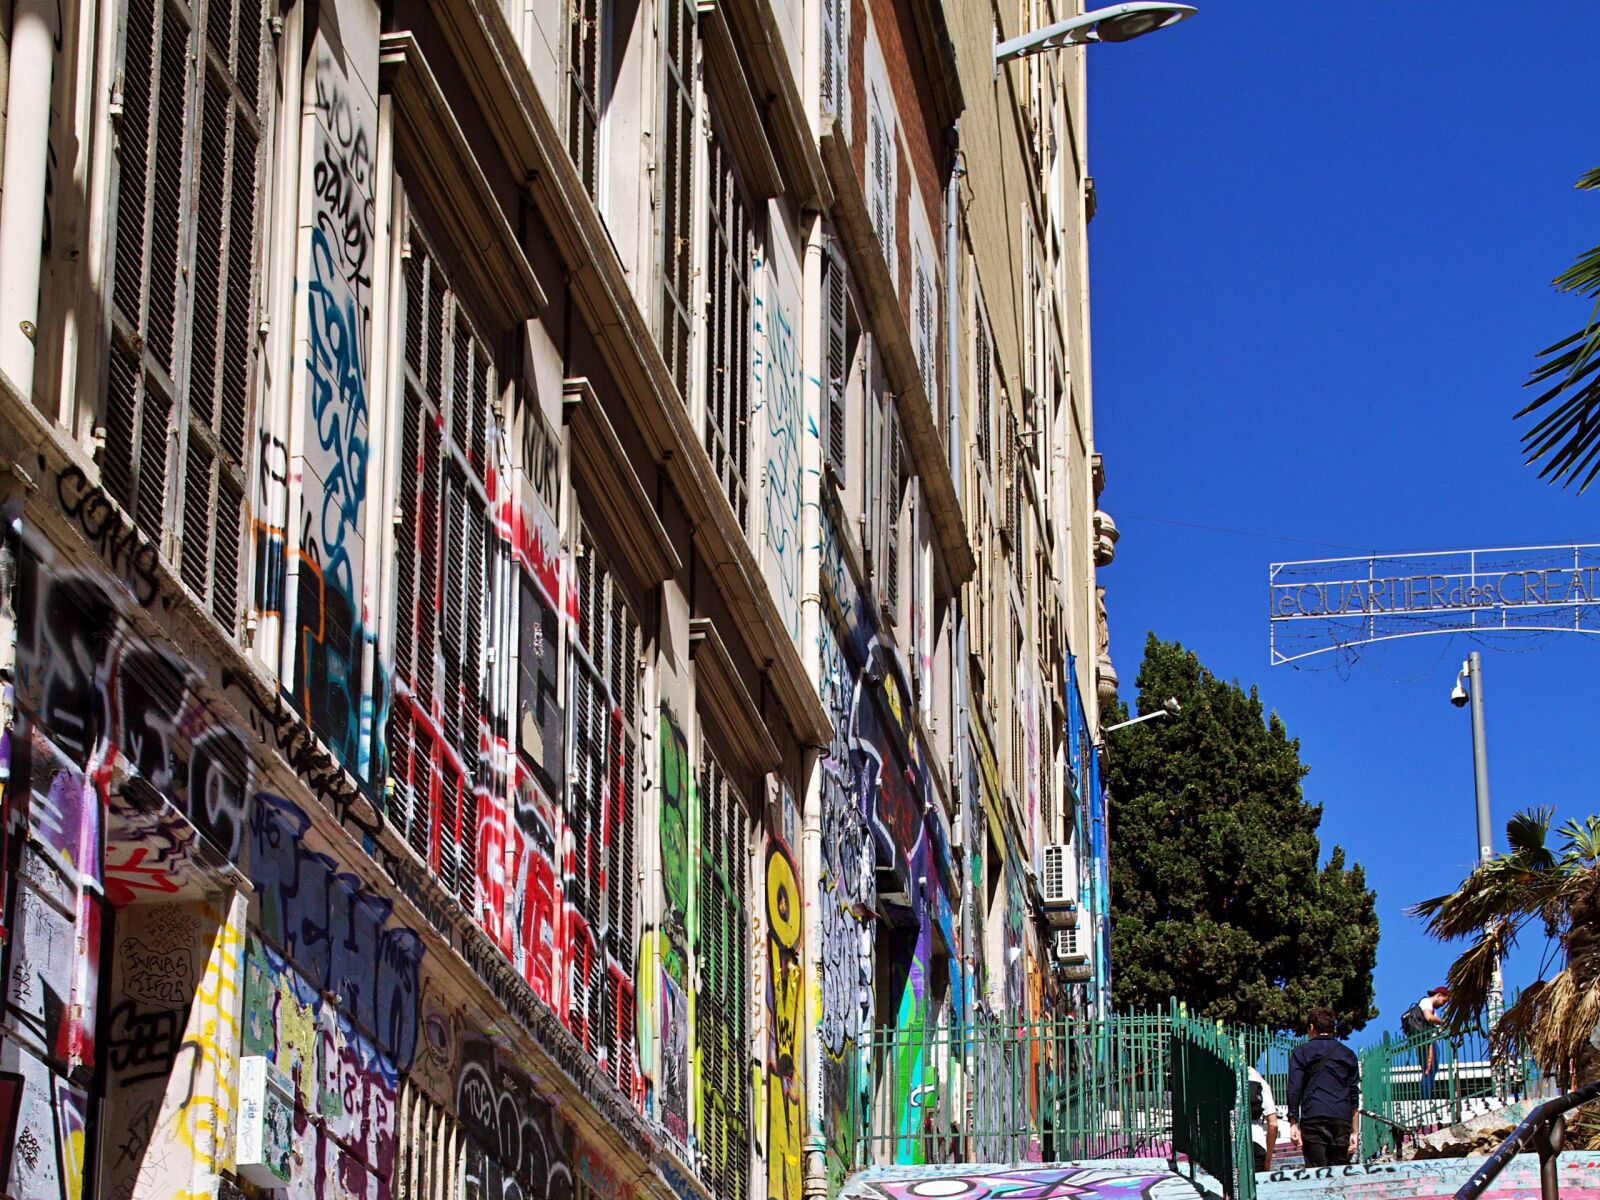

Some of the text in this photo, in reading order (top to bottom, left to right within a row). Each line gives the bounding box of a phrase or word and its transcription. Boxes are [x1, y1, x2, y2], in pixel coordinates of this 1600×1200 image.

[1270, 585, 1295, 618] Le
[1297, 575, 1448, 616] QUARTIER
[1449, 577, 1494, 607] des
